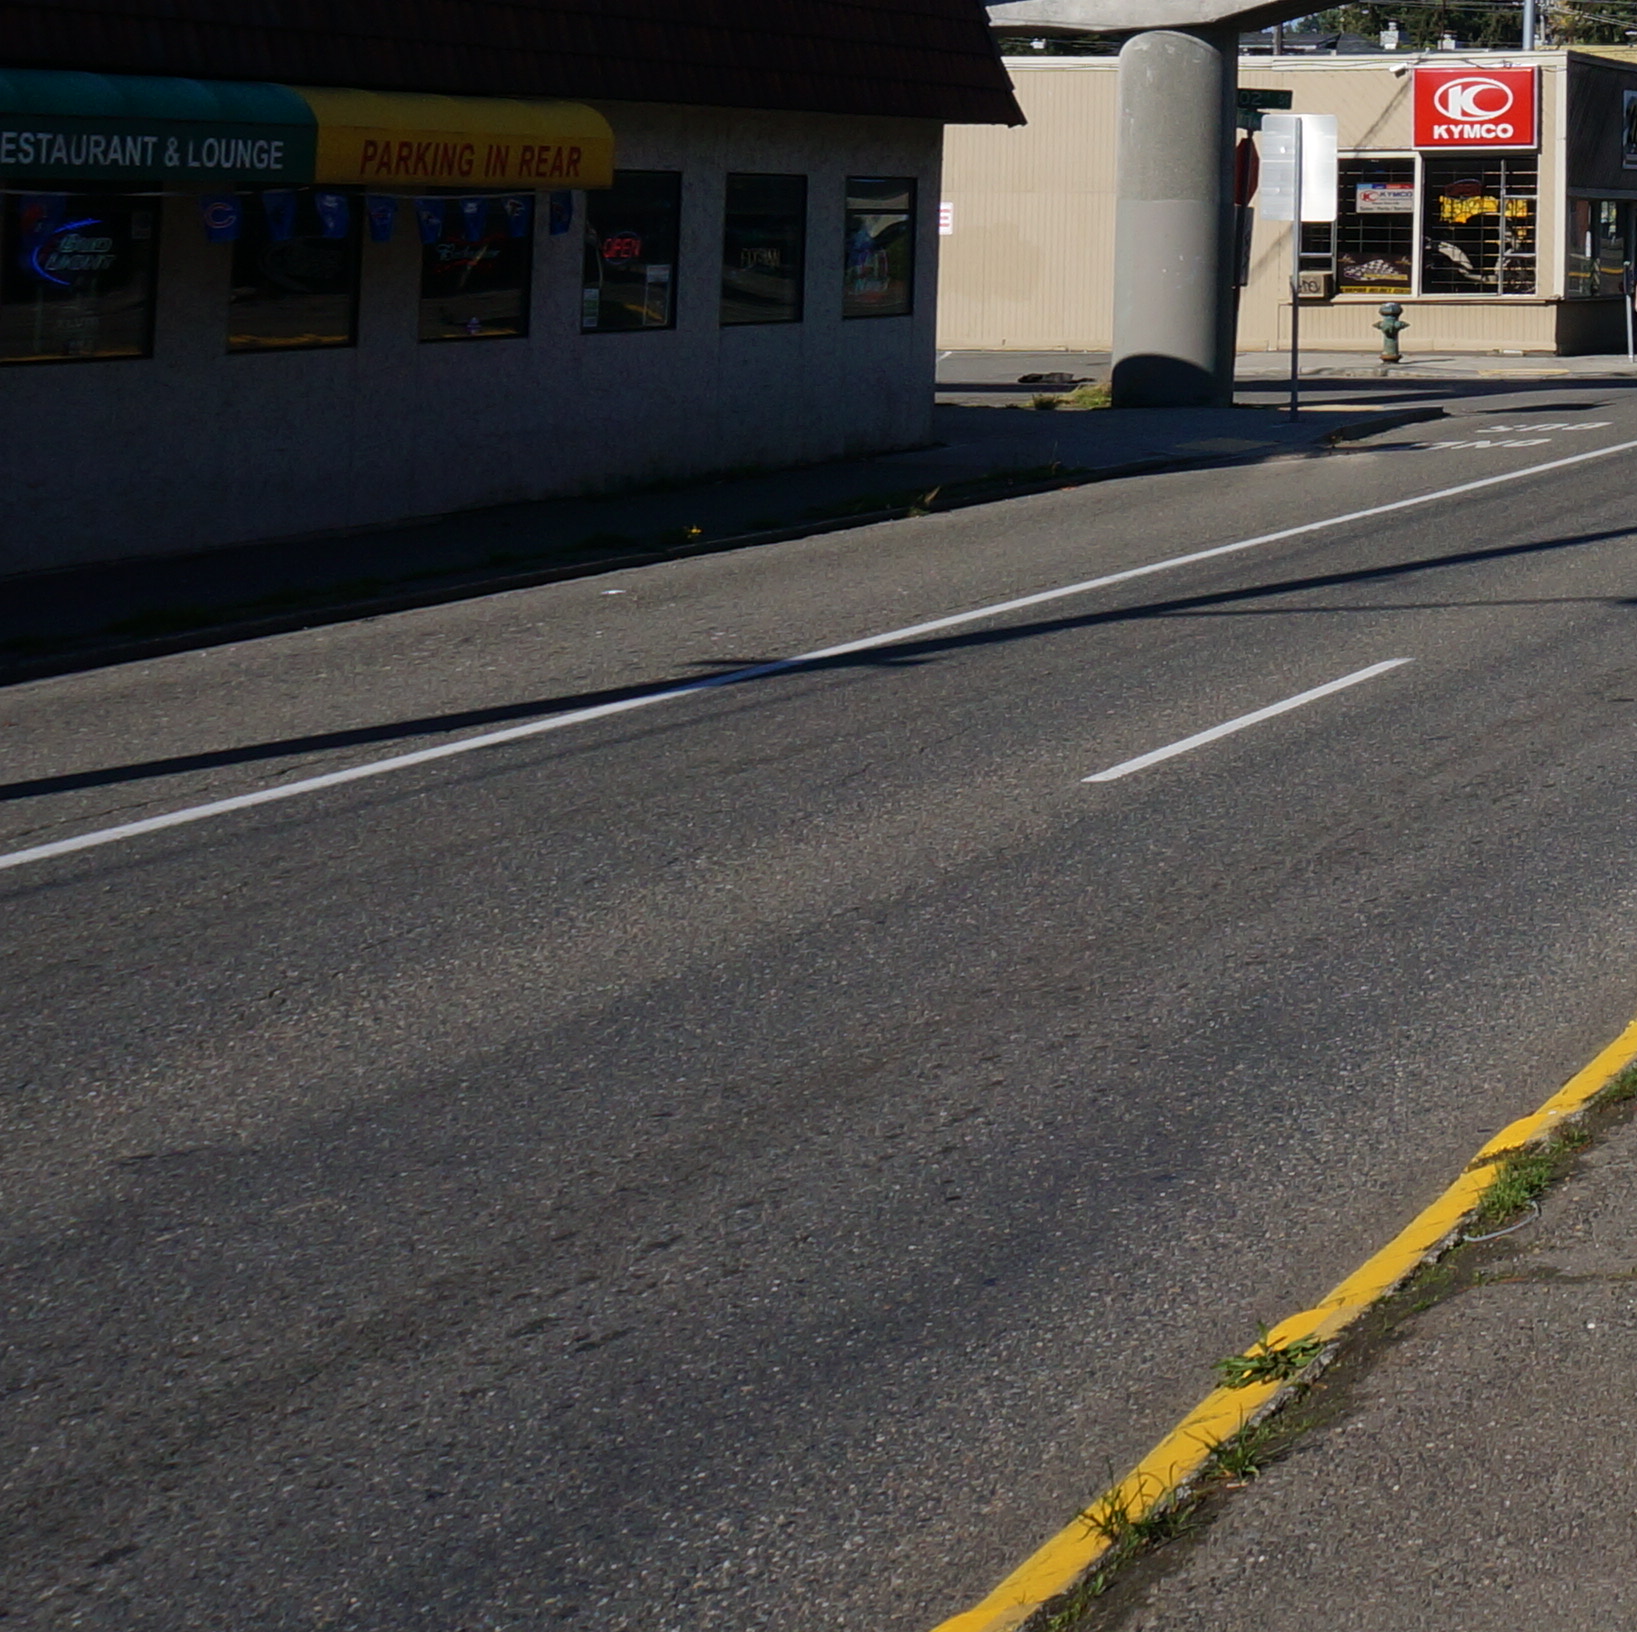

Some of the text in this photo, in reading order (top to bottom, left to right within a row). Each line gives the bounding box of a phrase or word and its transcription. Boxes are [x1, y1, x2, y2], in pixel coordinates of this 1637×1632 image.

[1433, 123, 1514, 140] KYMCO
[0, 131, 284, 169] ESTAURANT & LOUNGE
[360, 139, 582, 178] PARKING IN REAR
[601, 236, 642, 259] OPEN
